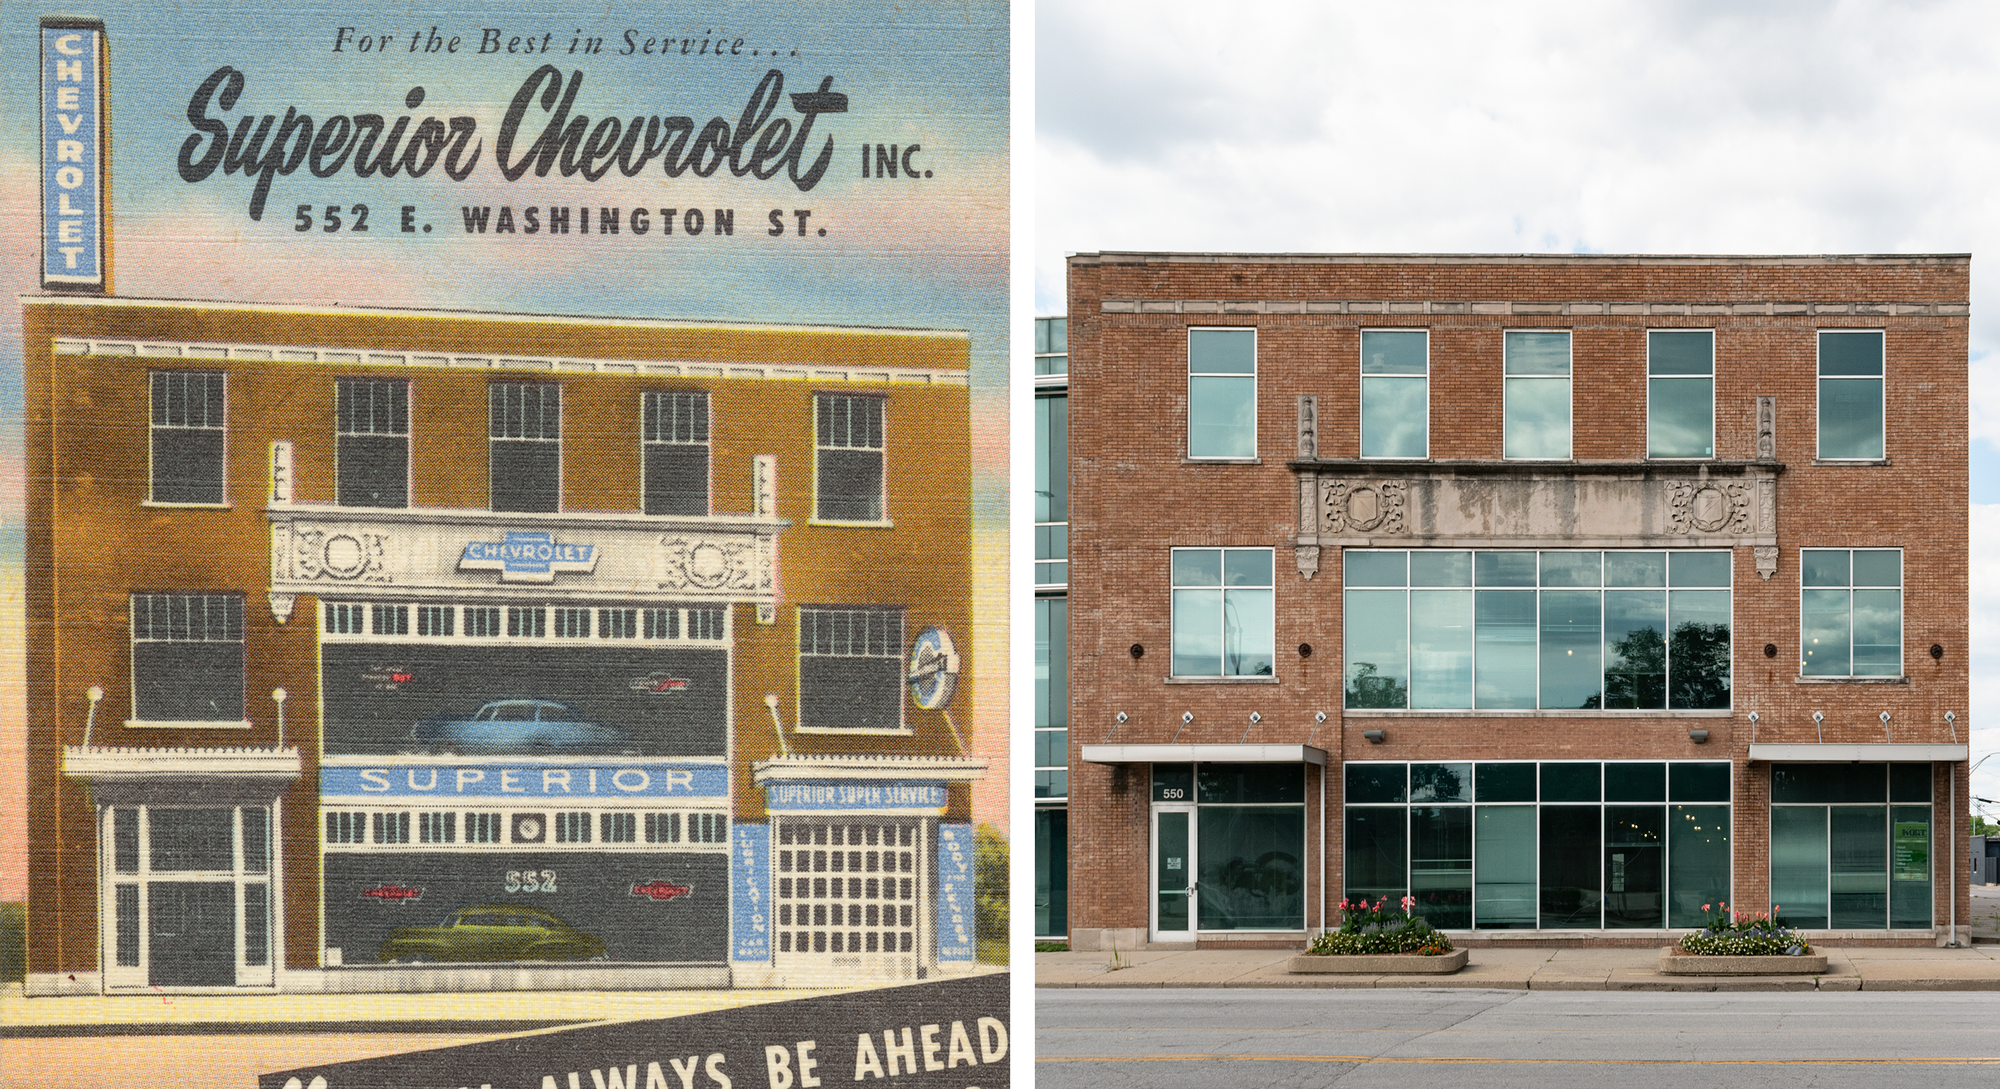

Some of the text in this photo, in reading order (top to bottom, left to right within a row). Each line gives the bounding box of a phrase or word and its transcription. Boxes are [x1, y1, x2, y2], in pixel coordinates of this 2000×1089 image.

[332, 27, 394, 53] For
[409, 26, 462, 54] the
[478, 27, 553, 55] Best
[568, 28, 602, 55] in
[54, 33, 85, 270] CHEVROLET
[177, 64, 934, 222] Superior Chevrolet INC.
[294, 204, 828, 238] 552 E. WASHINGTON ST.
[469, 542, 588, 562] CHEVROLET
[359, 768, 695, 794] SUPERIOR
[770, 785, 945, 804] SUPERIOR SUPER SERVICE
[1163, 788, 1184, 799] 550
[505, 869, 558, 893] 552
[765, 1040, 822, 1089] BE
[854, 1016, 1009, 1082] AHEAD
